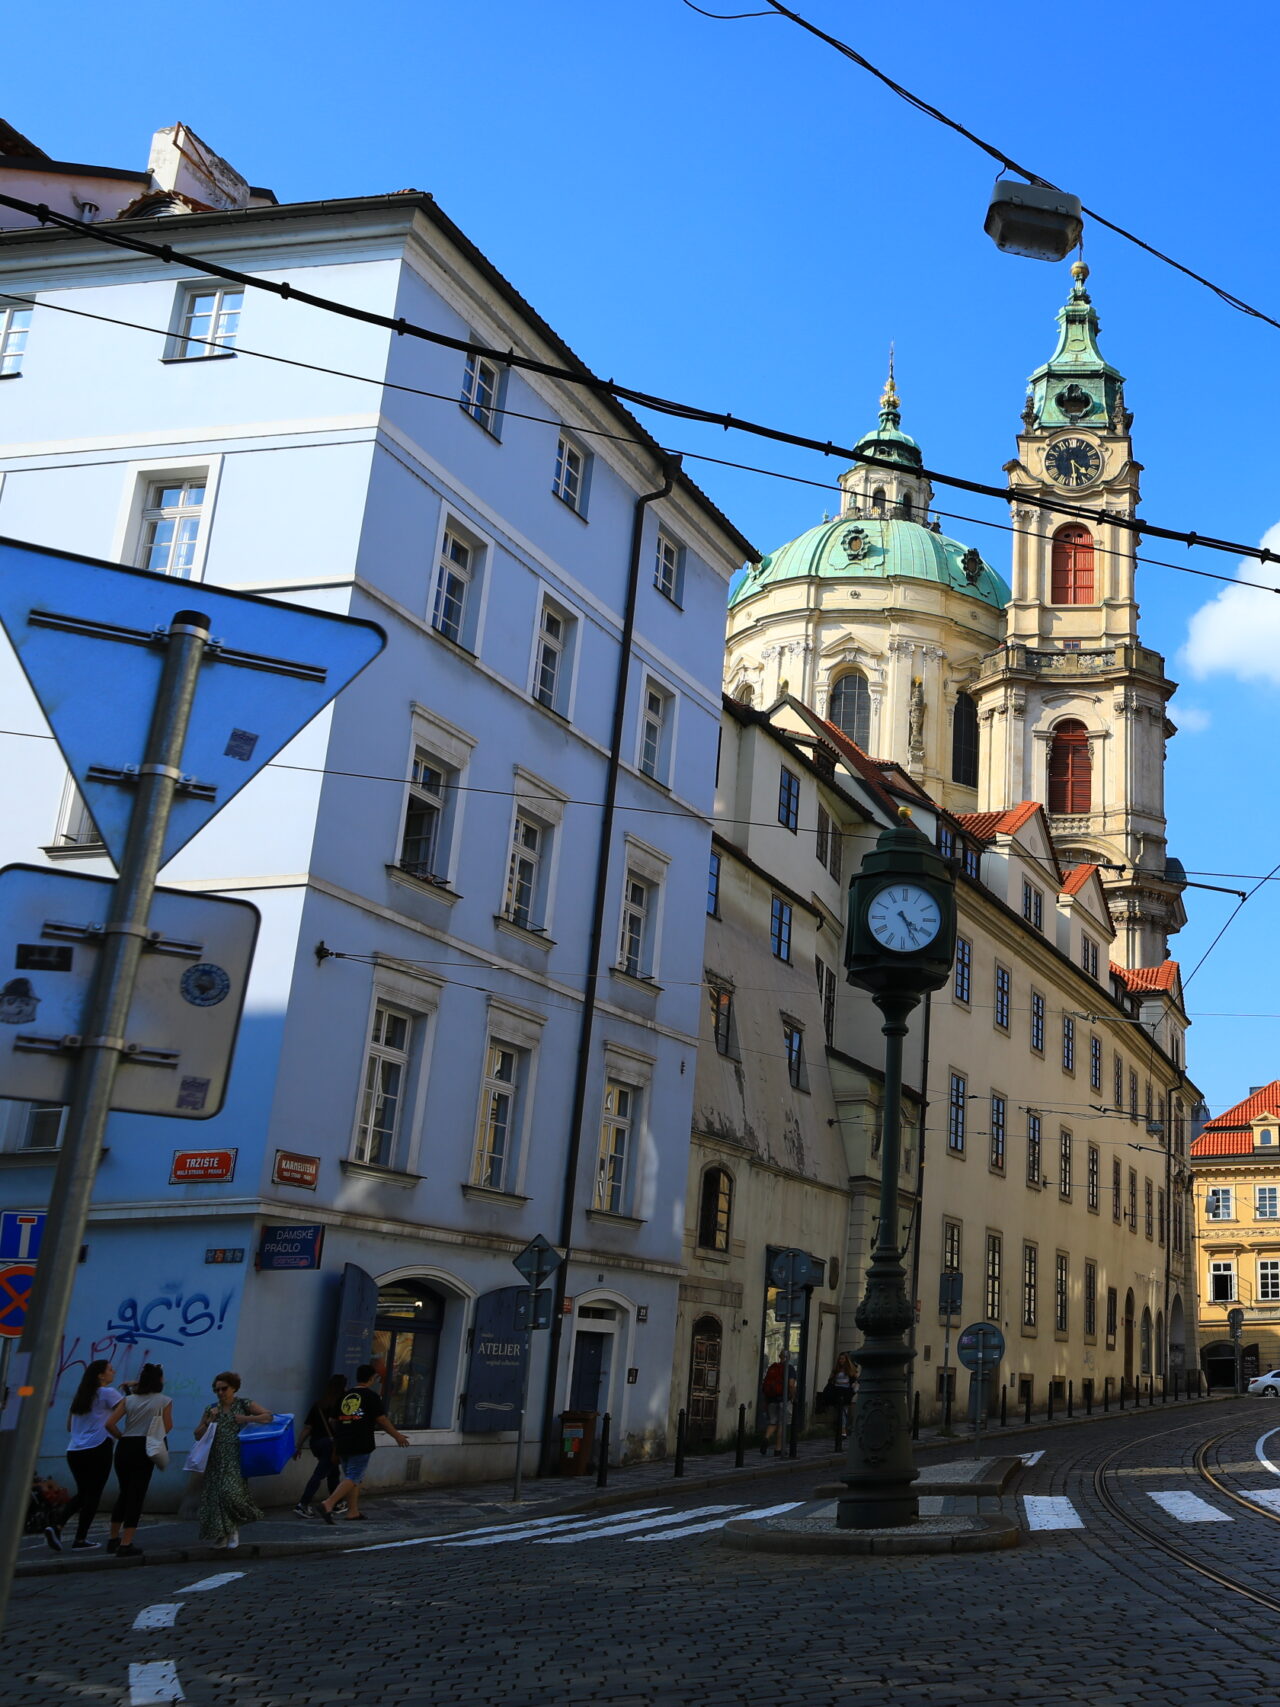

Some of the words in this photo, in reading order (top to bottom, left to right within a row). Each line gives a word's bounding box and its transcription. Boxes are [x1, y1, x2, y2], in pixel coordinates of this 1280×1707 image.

[276, 1228, 314, 1240] DÁMSKÉ
[264, 1241, 301, 1253] PRÁDLO
[477, 1342, 520, 1357] ATELIER
